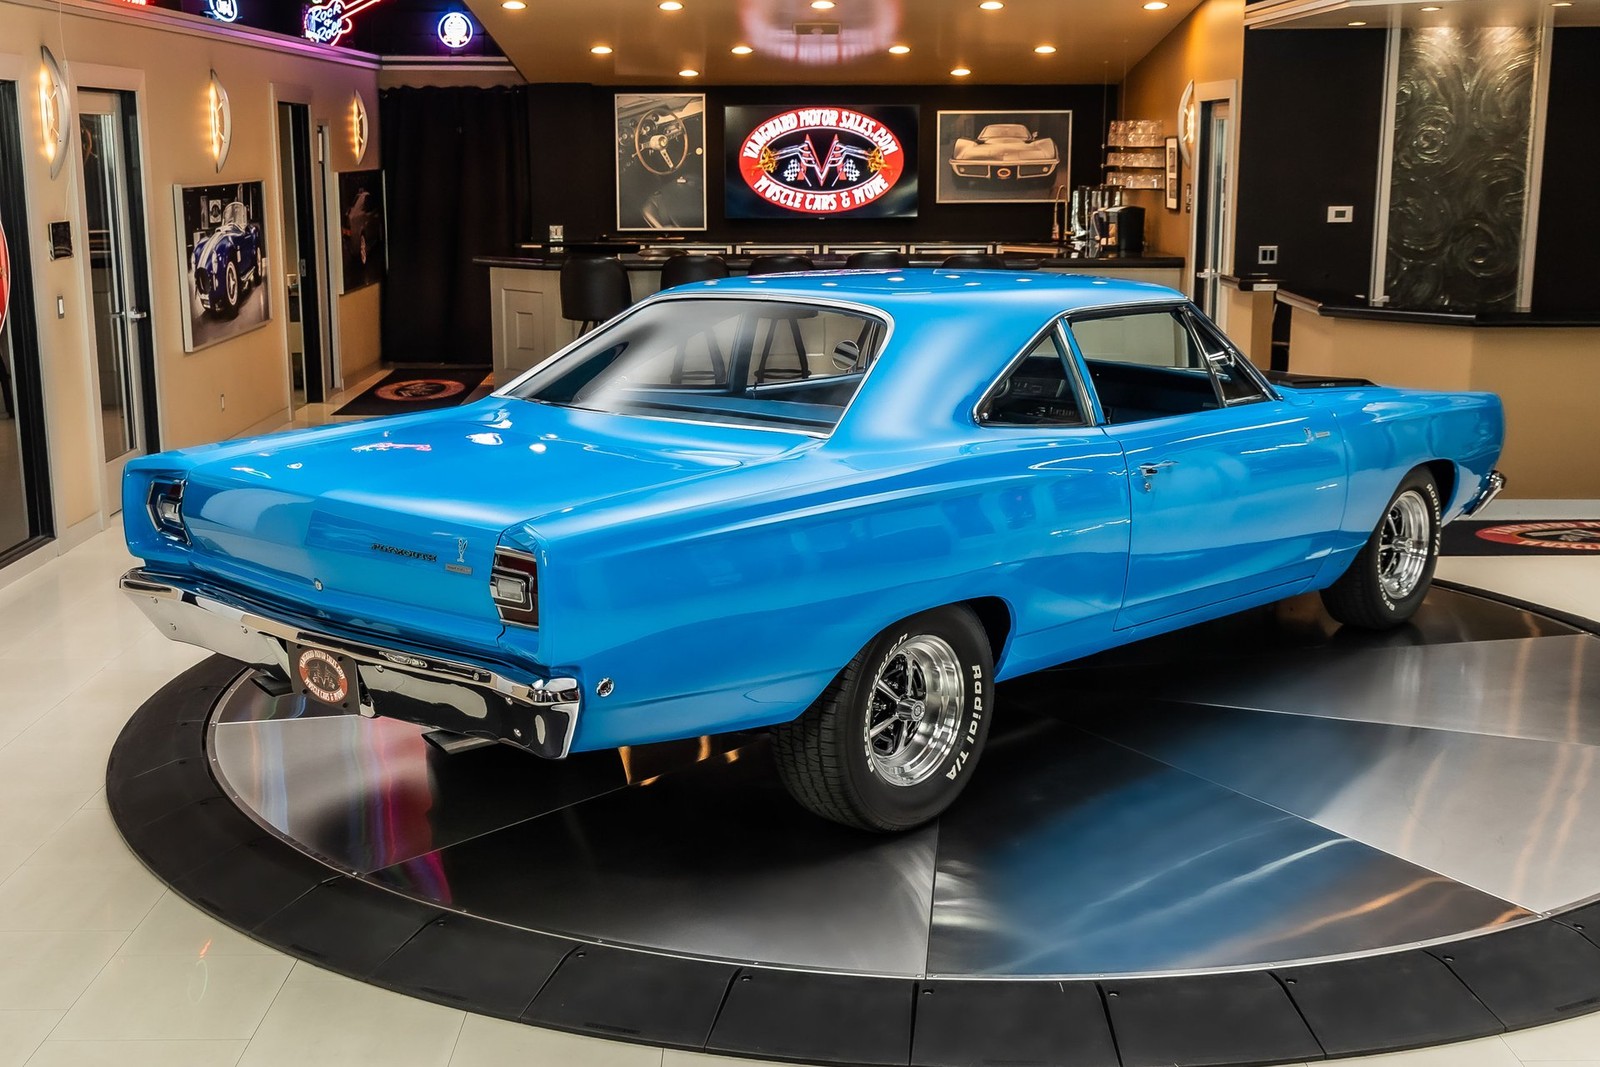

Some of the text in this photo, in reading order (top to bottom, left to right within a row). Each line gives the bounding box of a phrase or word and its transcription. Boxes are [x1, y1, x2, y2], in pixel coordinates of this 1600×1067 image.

[311, 0, 342, 23] Rock
[316, 18, 343, 41] Roll
[743, 109, 899, 159] VANGUARD MOTOR SALES.COM
[753, 174, 889, 211] MUSCLE CARS & MORE
[371, 543, 438, 562] PLYMOUTH
[945, 664, 983, 780] Radial T/A
